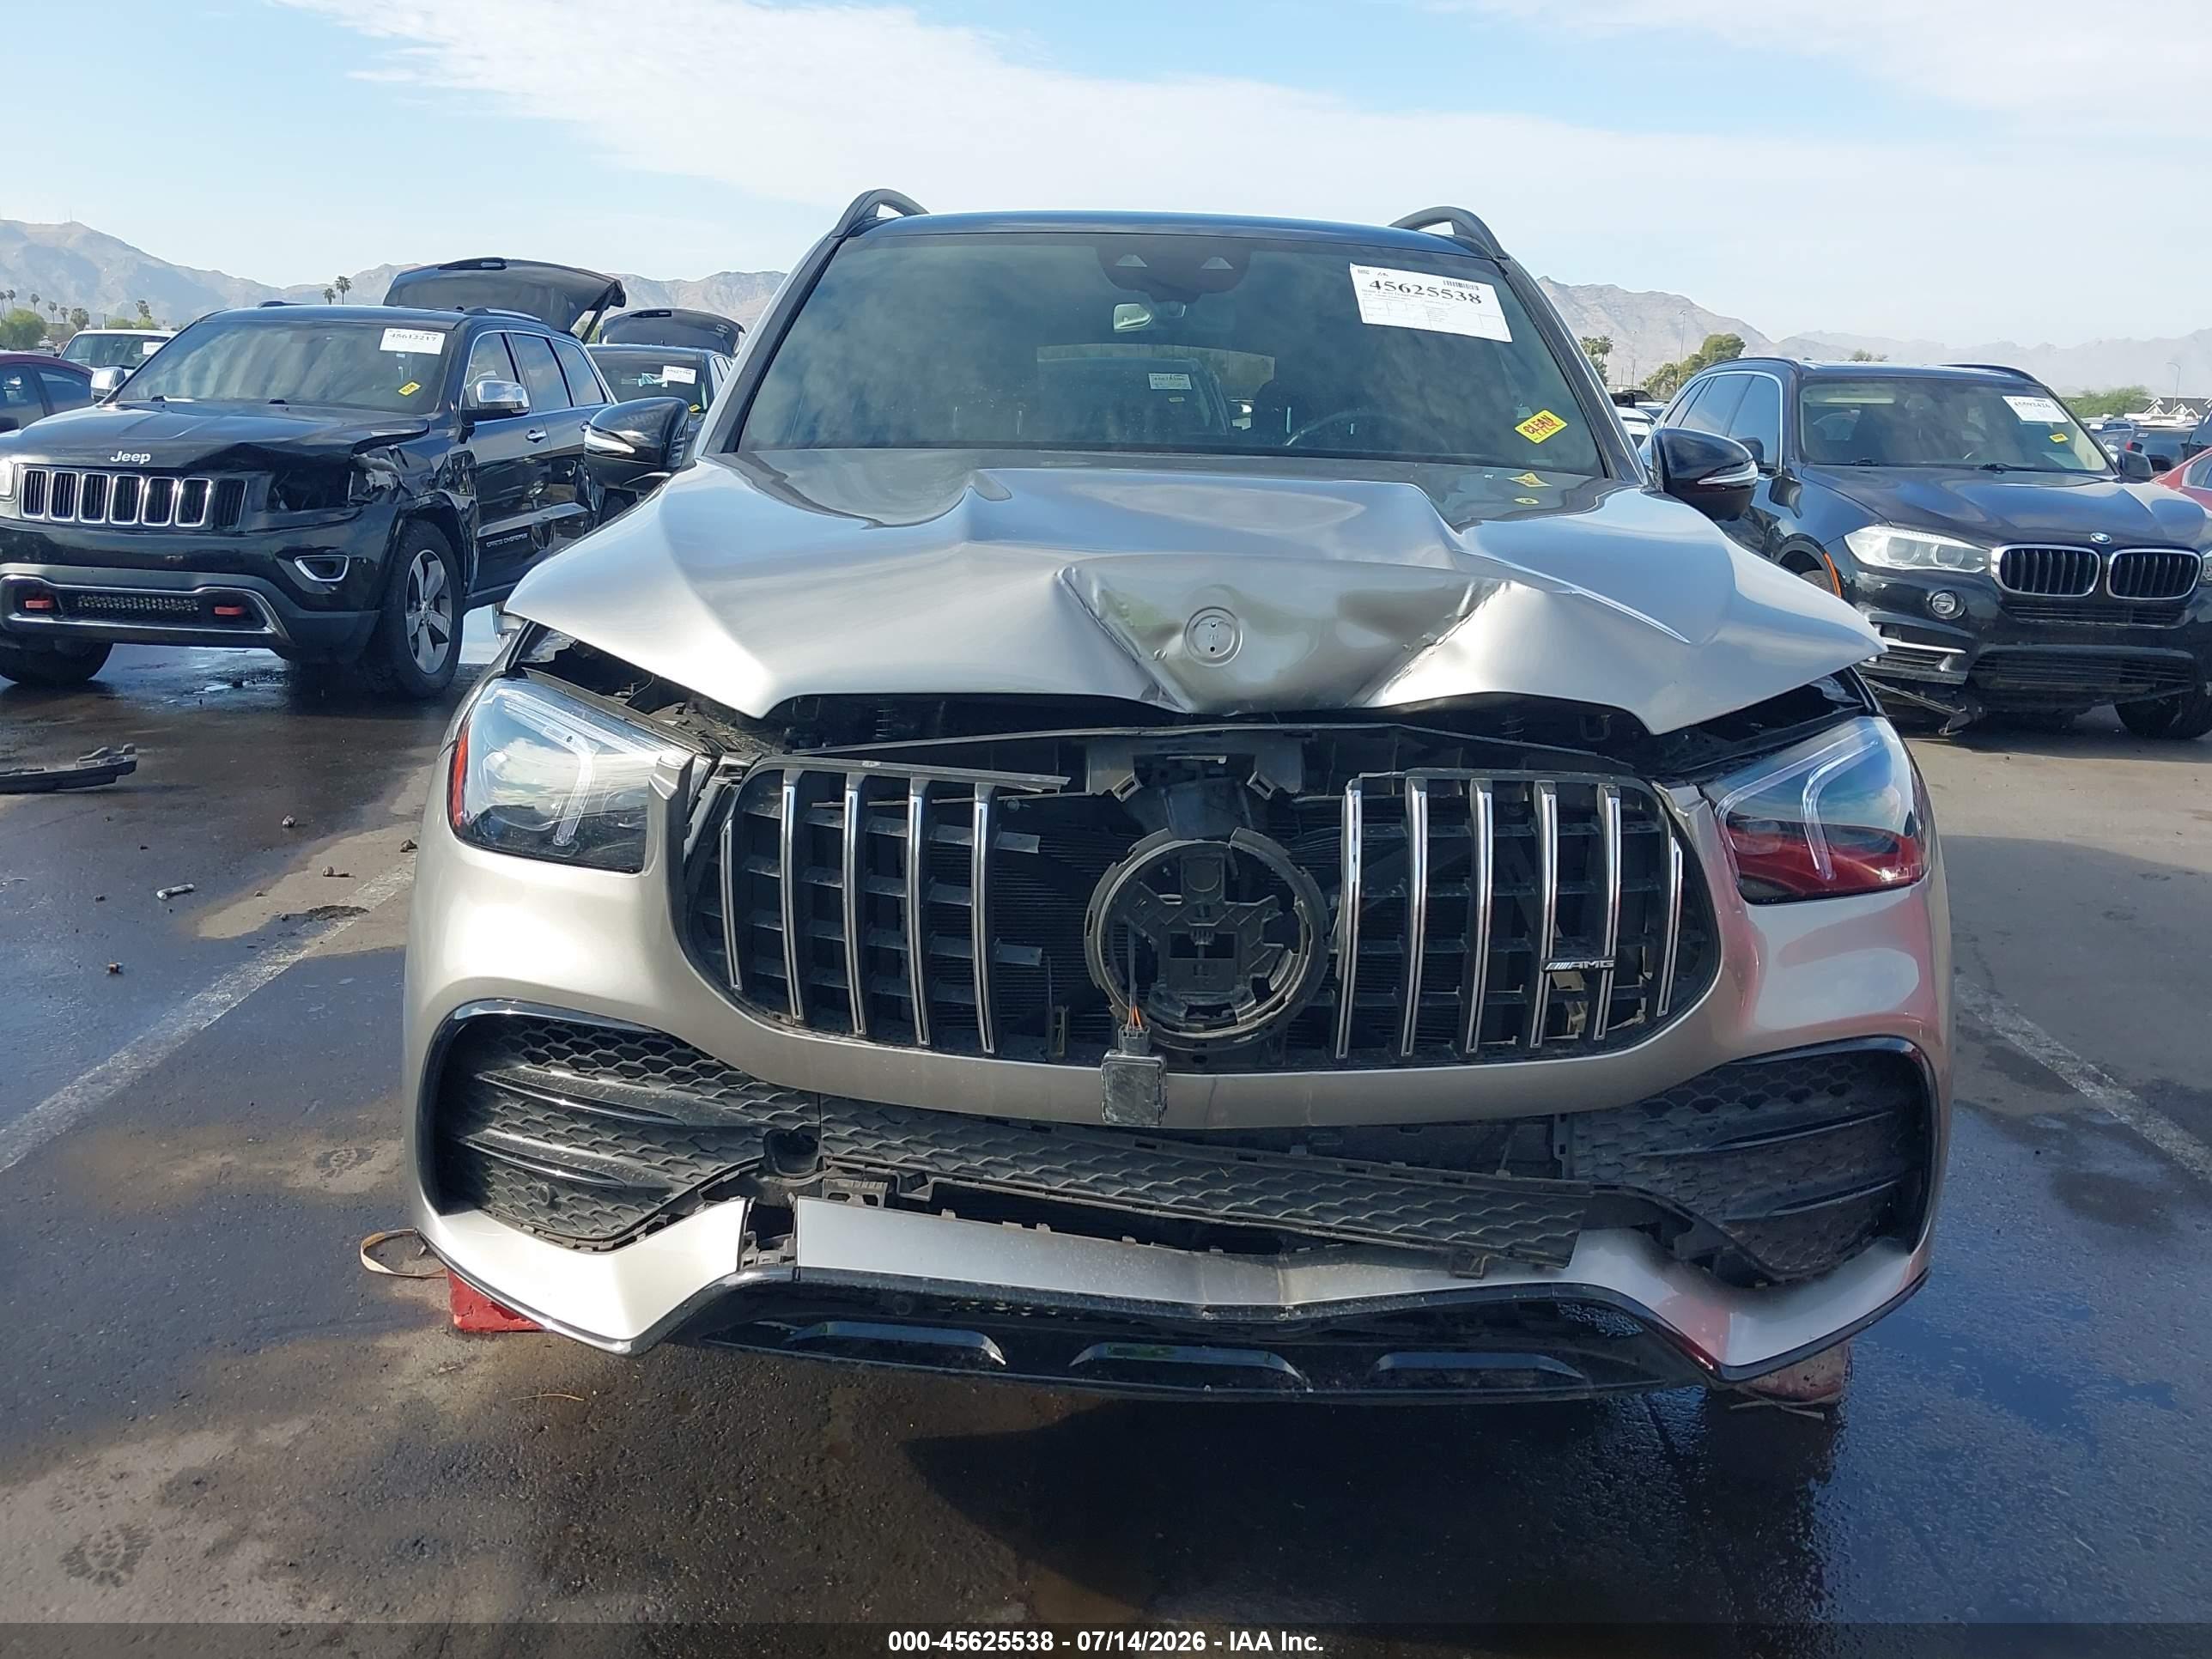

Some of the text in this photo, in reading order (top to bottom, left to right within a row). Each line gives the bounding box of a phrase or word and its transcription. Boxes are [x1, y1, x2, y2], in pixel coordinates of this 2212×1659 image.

[1369, 279, 1483, 305] 45625538
[110, 450, 151, 465] Jeep
[1568, 959, 1614, 969] AMG
